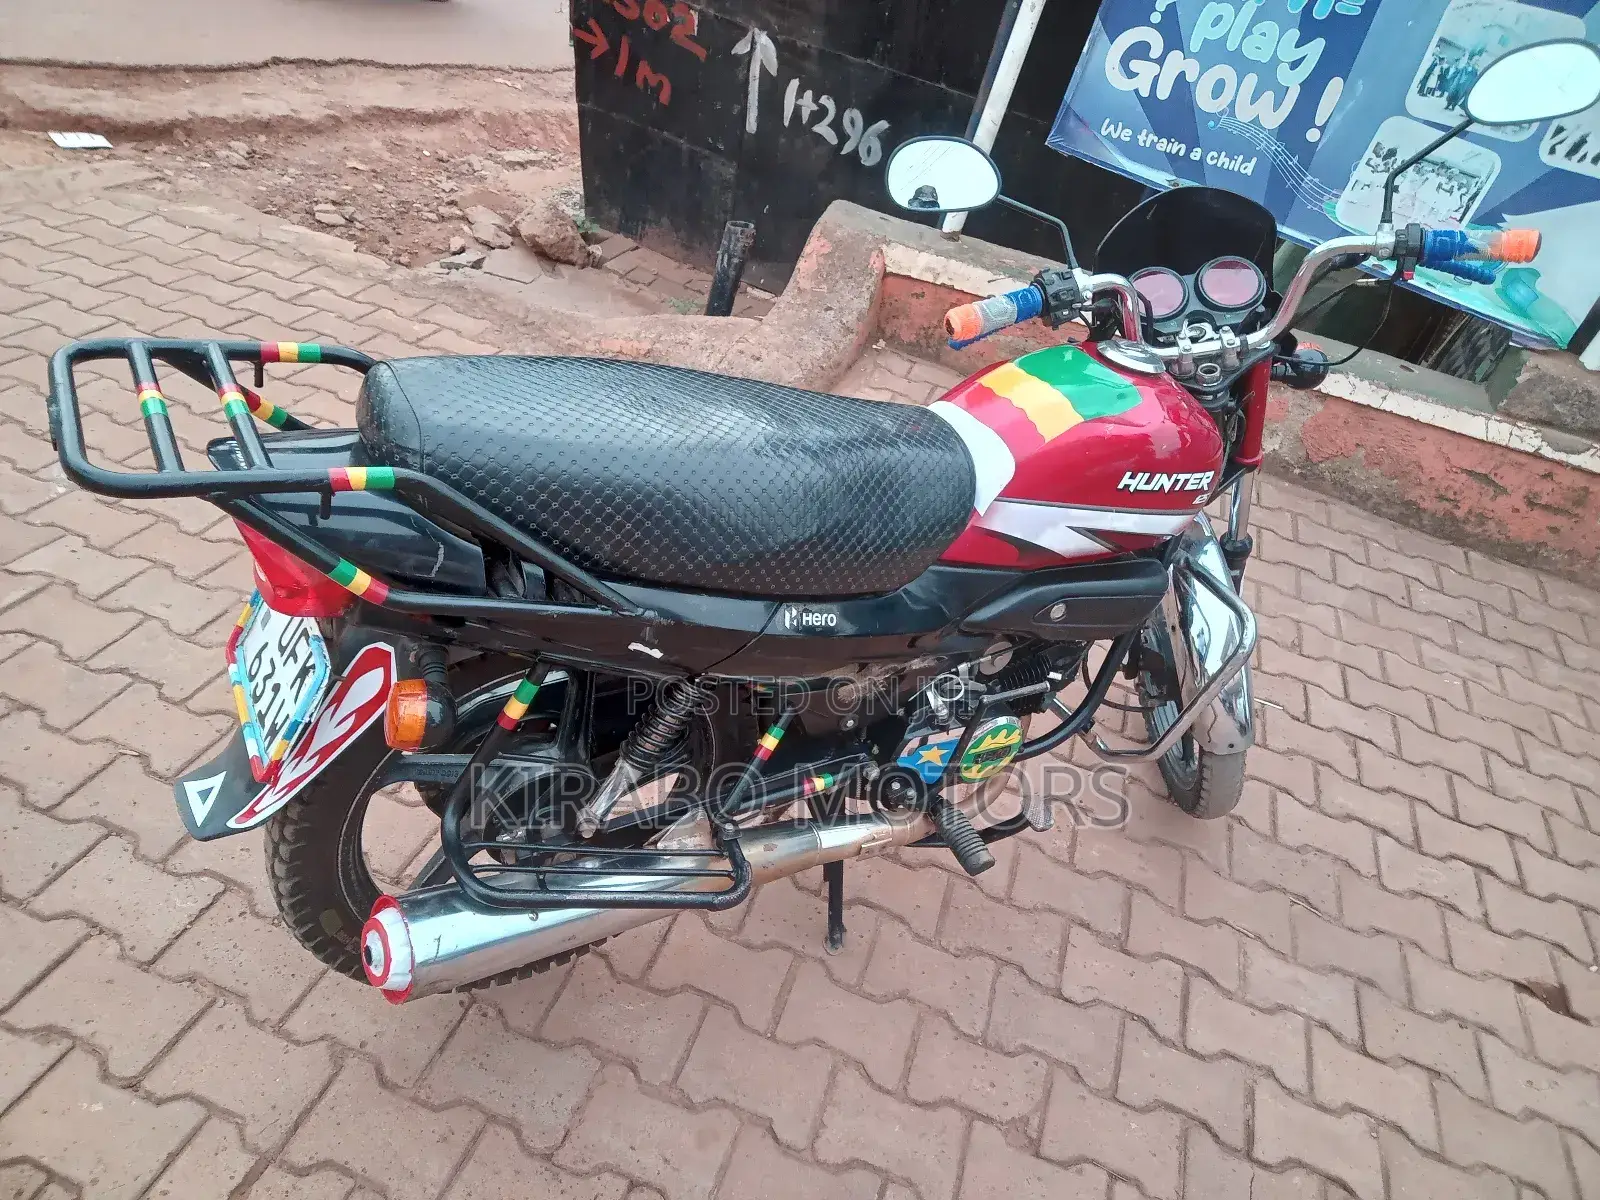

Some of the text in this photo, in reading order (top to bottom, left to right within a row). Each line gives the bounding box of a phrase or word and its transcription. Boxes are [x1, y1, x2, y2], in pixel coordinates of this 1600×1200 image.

[1189, 0, 1327, 87] play
[1100, 117, 1258, 177] We train a child
[1116, 470, 1216, 494] HUNTER
[802, 612, 837, 627] Hero
